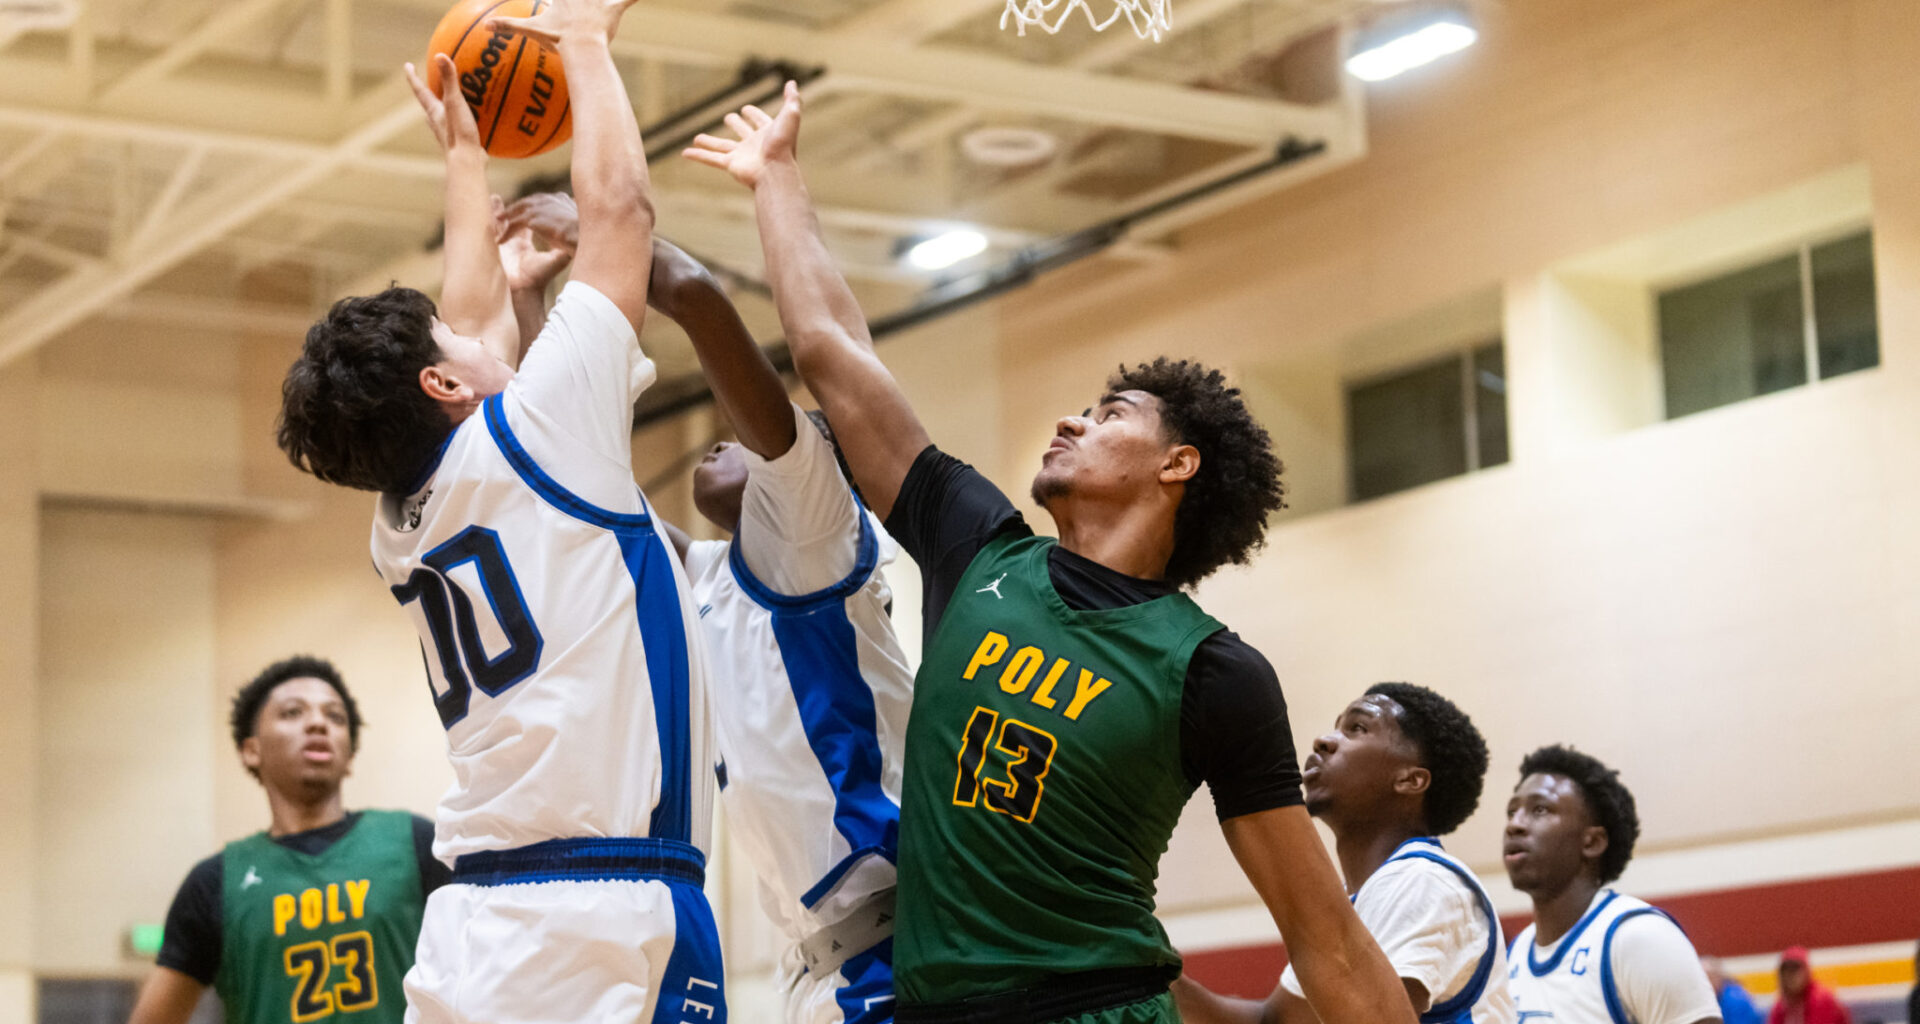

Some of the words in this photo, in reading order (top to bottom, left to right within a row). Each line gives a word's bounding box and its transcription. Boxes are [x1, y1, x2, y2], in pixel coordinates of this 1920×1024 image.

[461, 31, 514, 122] ilson
[518, 70, 555, 137] EVO
[962, 630, 1113, 721] POLY
[953, 705, 1058, 824] 13
[273, 878, 370, 936] POLY
[284, 930, 379, 1023] 23
[680, 976, 718, 1024] LE
[1570, 946, 1590, 976] C
